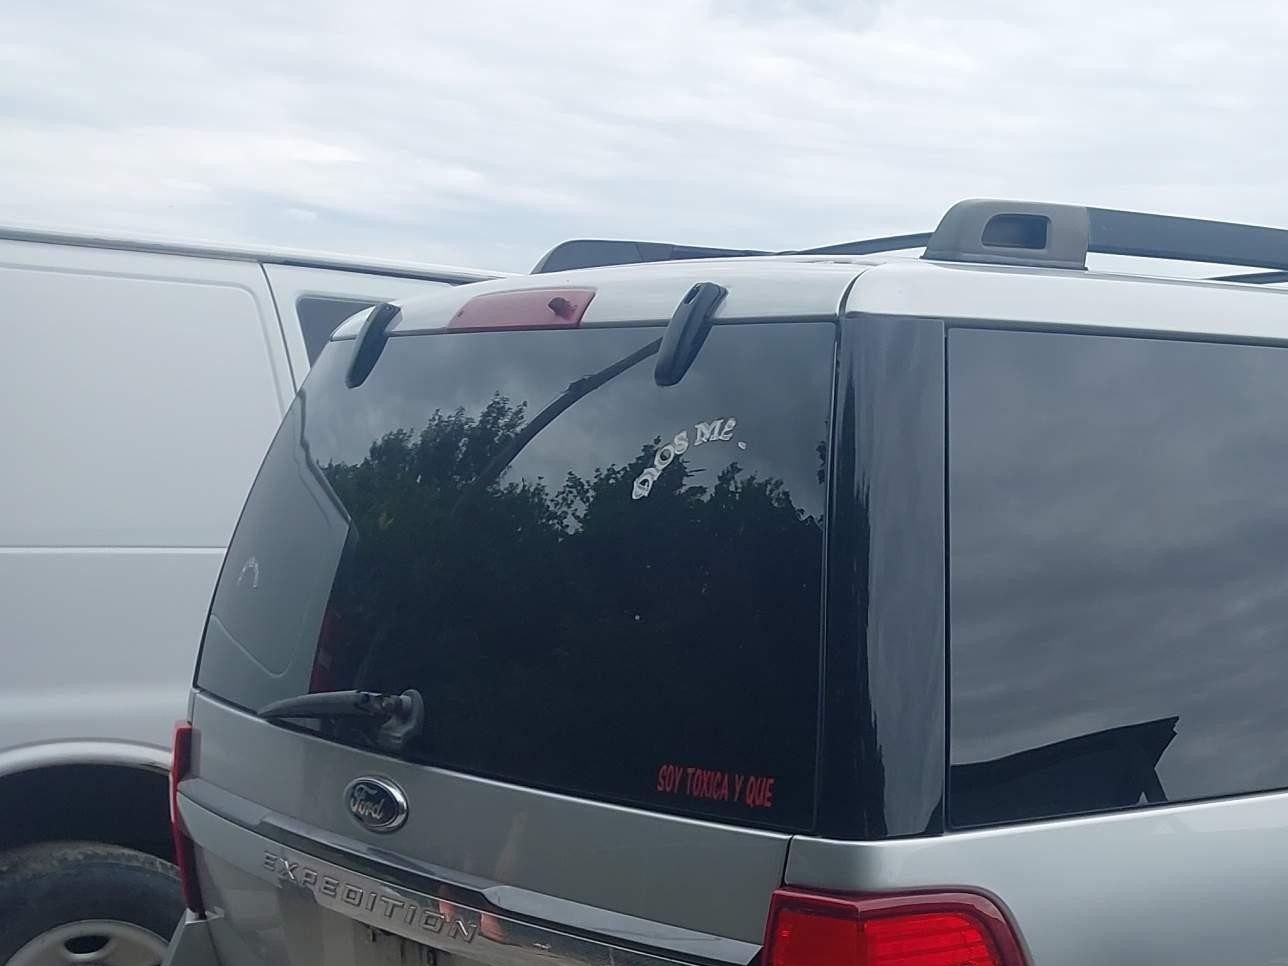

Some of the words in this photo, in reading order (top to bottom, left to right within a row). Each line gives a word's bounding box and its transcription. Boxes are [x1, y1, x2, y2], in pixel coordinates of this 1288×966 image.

[350, 784, 385, 820] Ford
[656, 764, 684, 793] SOY
[686, 767, 729, 800] TOXICA
[733, 774, 745, 802] Y
[746, 775, 775, 808] QUE
[263, 851, 479, 944] EXPEDITION
